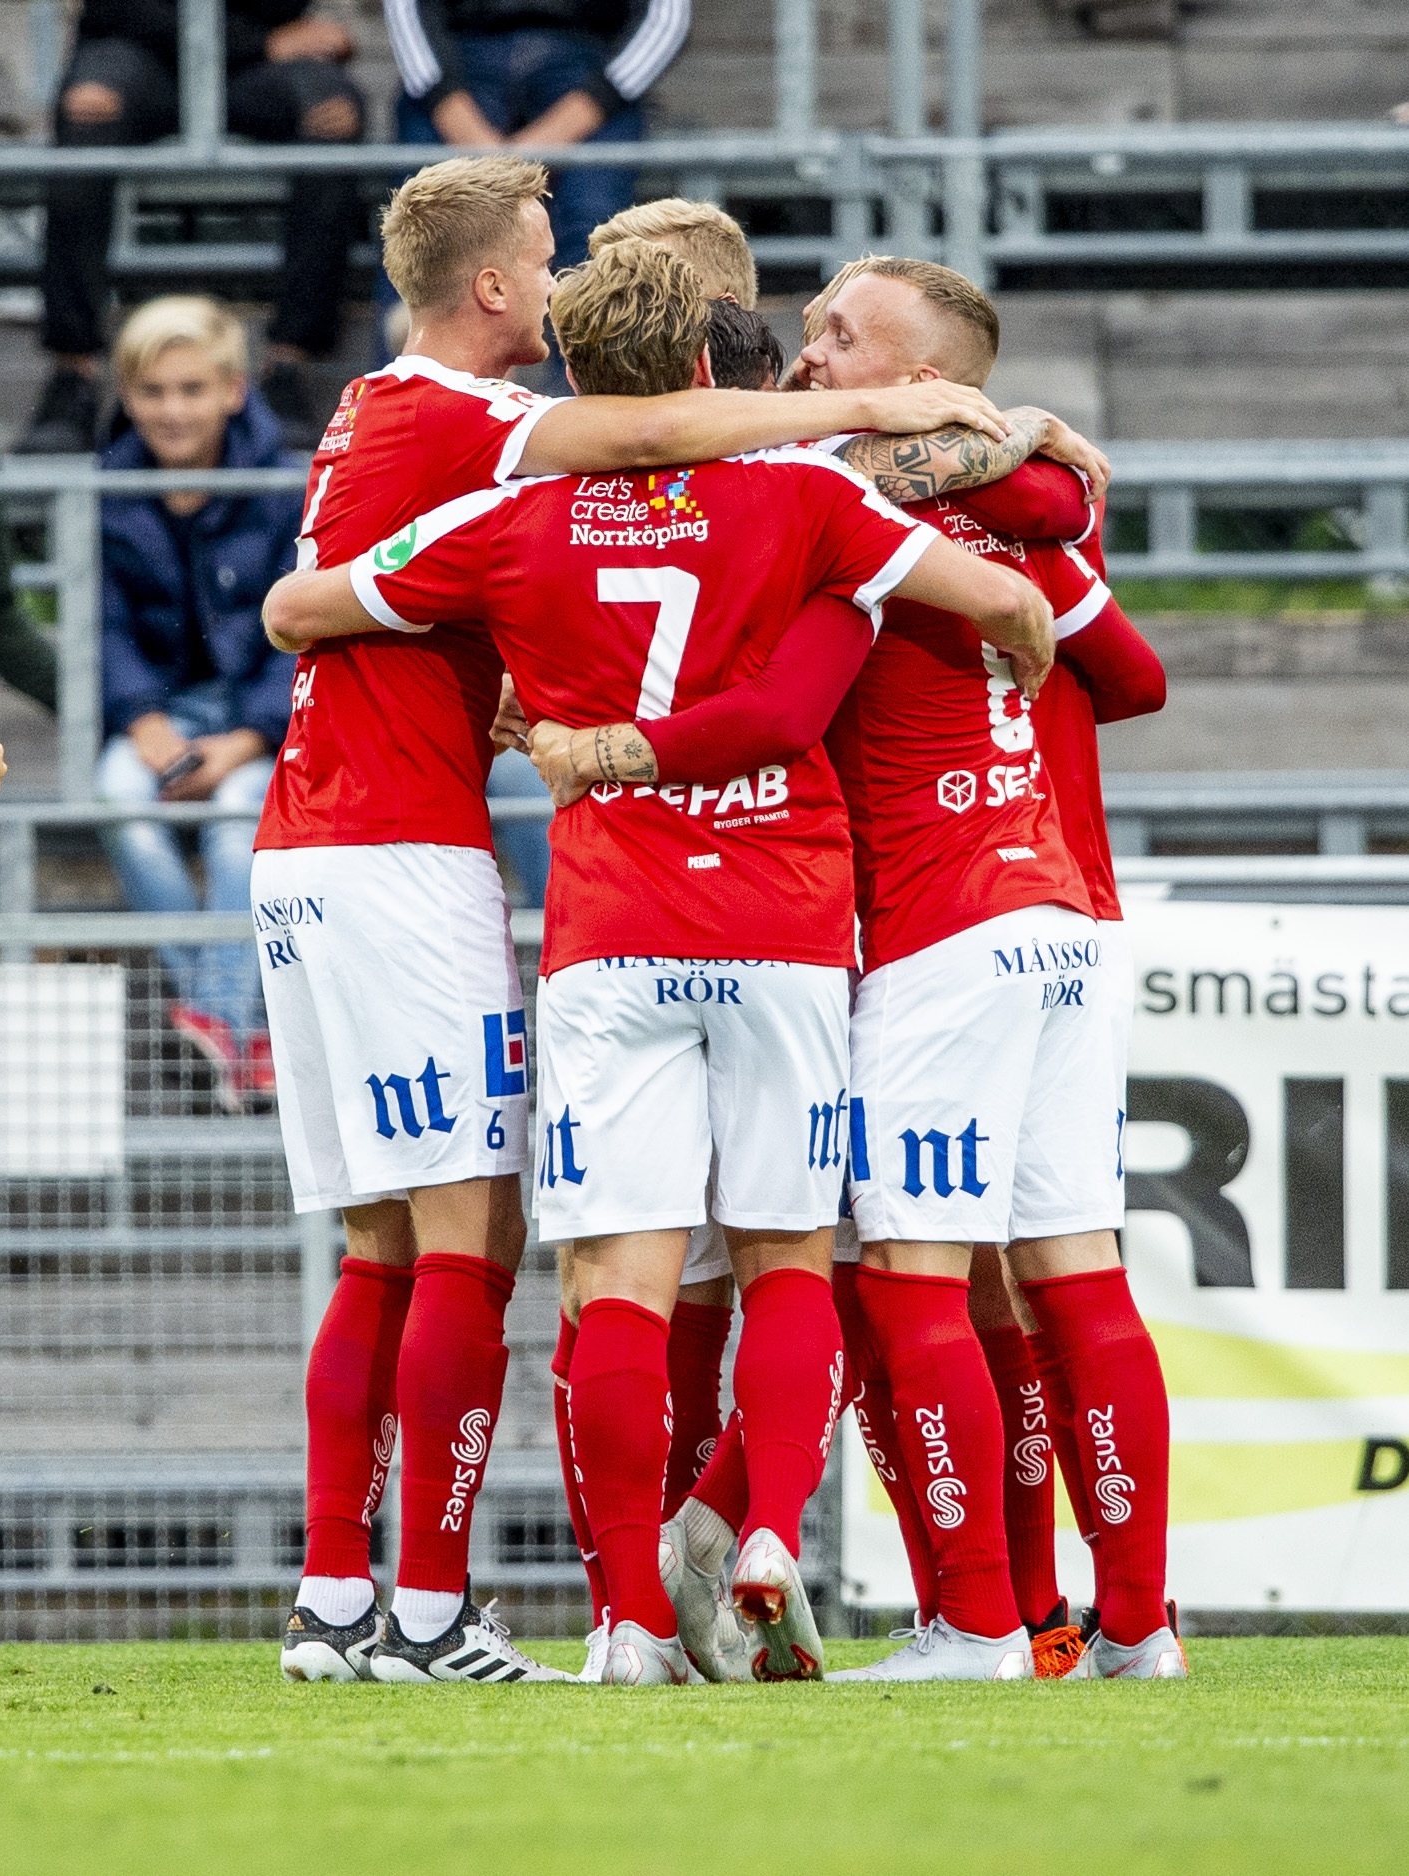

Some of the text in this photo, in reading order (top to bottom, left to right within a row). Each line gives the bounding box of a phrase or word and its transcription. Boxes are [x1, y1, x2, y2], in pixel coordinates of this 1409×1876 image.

[573, 476, 634, 500] Let's
[570, 499, 649, 522] create
[569, 518, 710, 550] Norrköping
[597, 565, 701, 722] 7
[713, 809, 790, 830] BYGGER FRAMTID
[687, 853, 722, 869] PEKING
[252, 896, 326, 933] NSSON
[264, 928, 304, 970] RÖ
[991, 937, 1102, 977] MÅNSSO
[652, 968, 744, 1005] RÖR
[1039, 974, 1085, 1010] RÖR
[365, 1056, 459, 1140] nt
[486, 1109, 506, 1151] 6
[898, 1117, 990, 1200] nt
[1019, 1379, 1047, 1431] sue
[915, 1403, 955, 1476] suez
[1086, 1404, 1123, 1472] suez
[440, 1464, 477, 1532] suez
